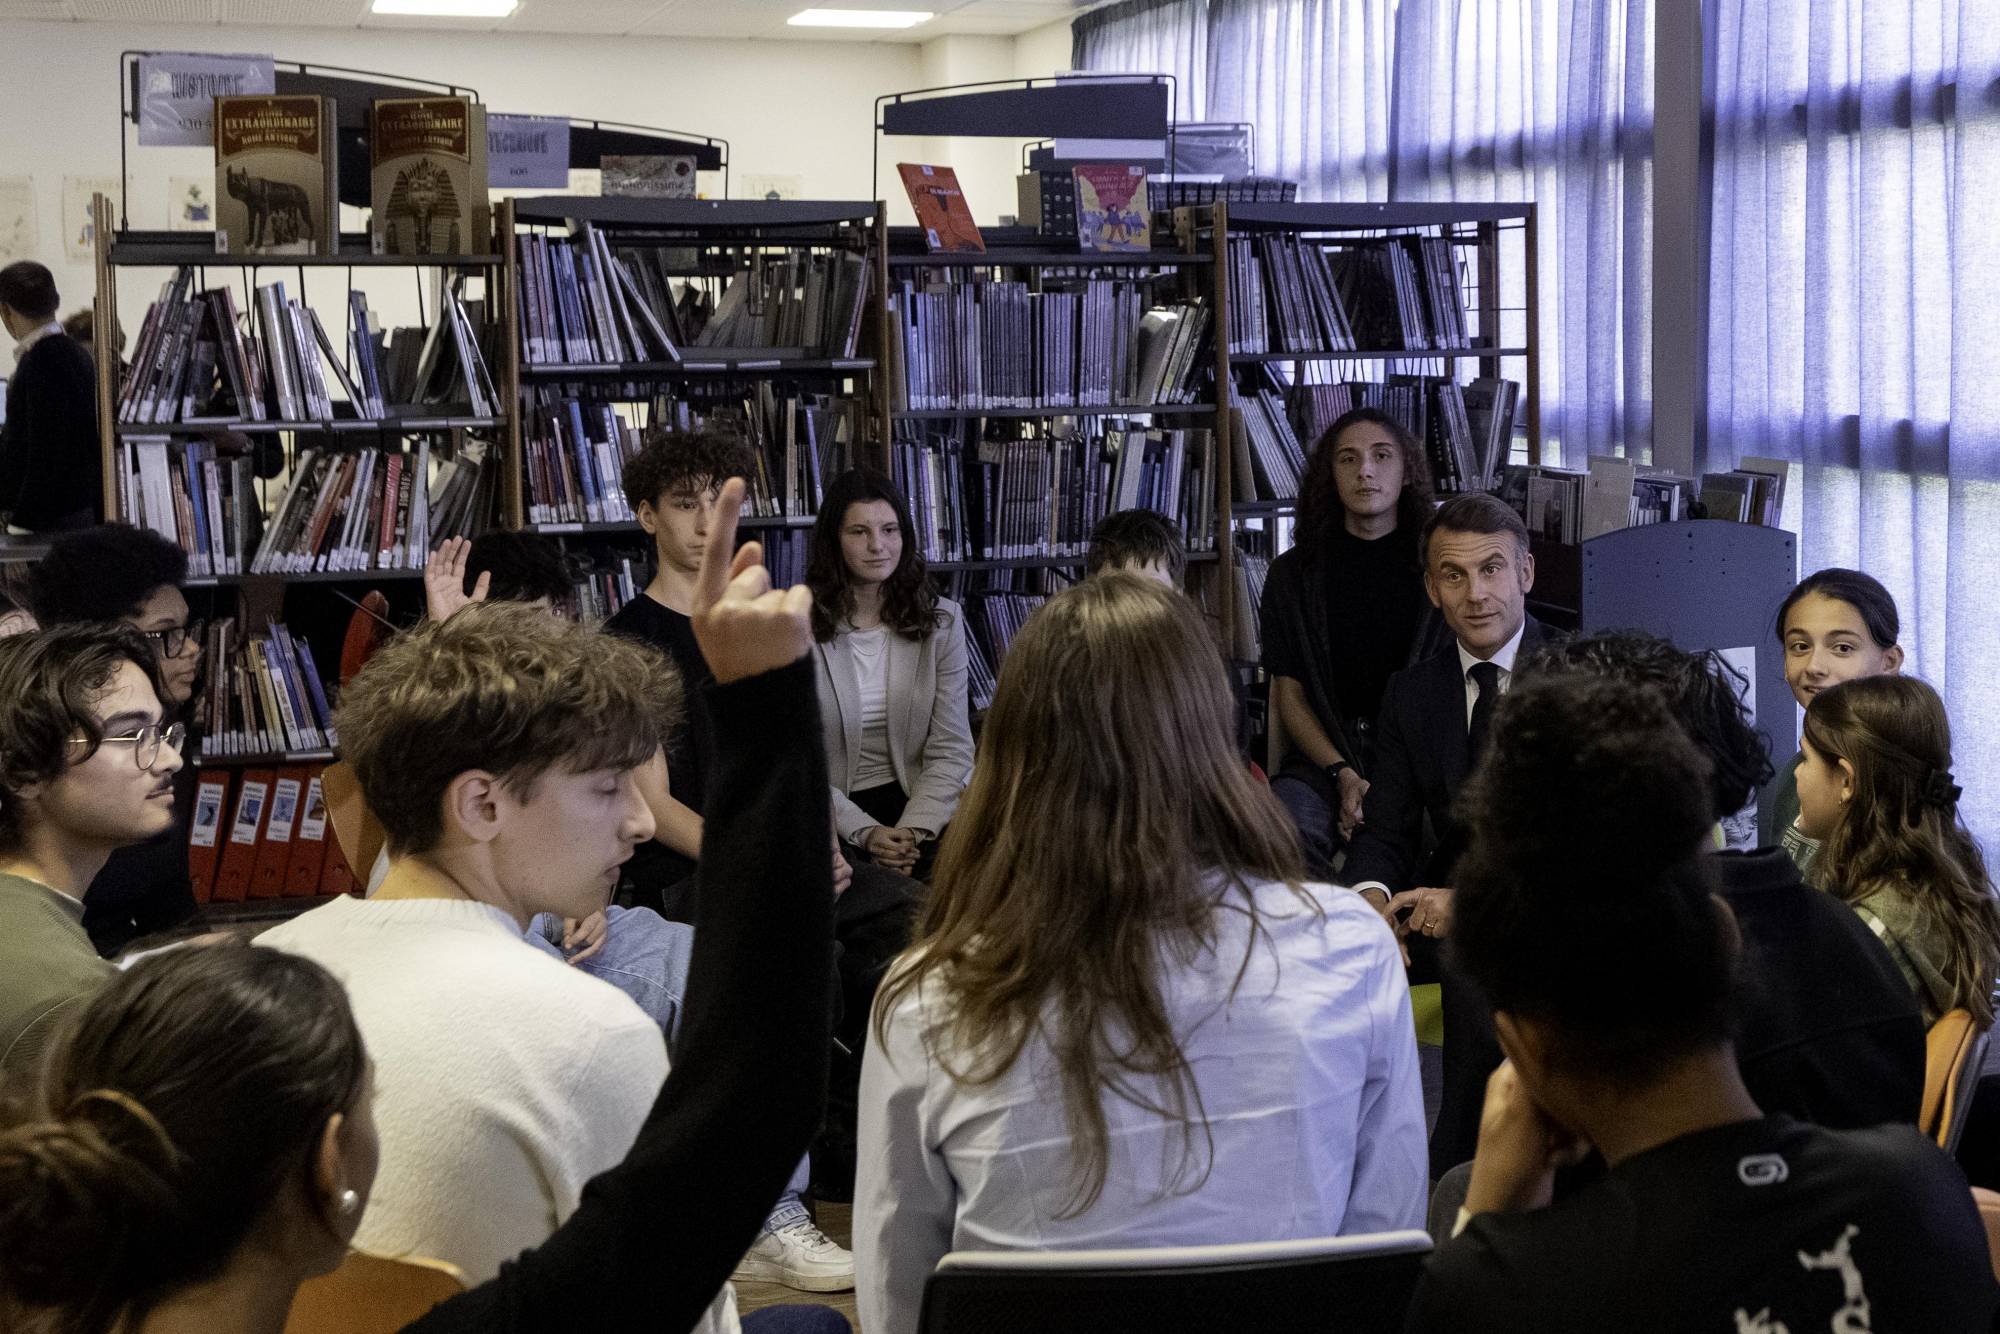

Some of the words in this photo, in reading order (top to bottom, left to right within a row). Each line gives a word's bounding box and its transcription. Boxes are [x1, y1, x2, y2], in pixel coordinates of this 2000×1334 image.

[224, 116, 315, 129] EXTRAORDINAIRE
[241, 132, 263, 145] ROME
[264, 132, 298, 145] ANTIQUE
